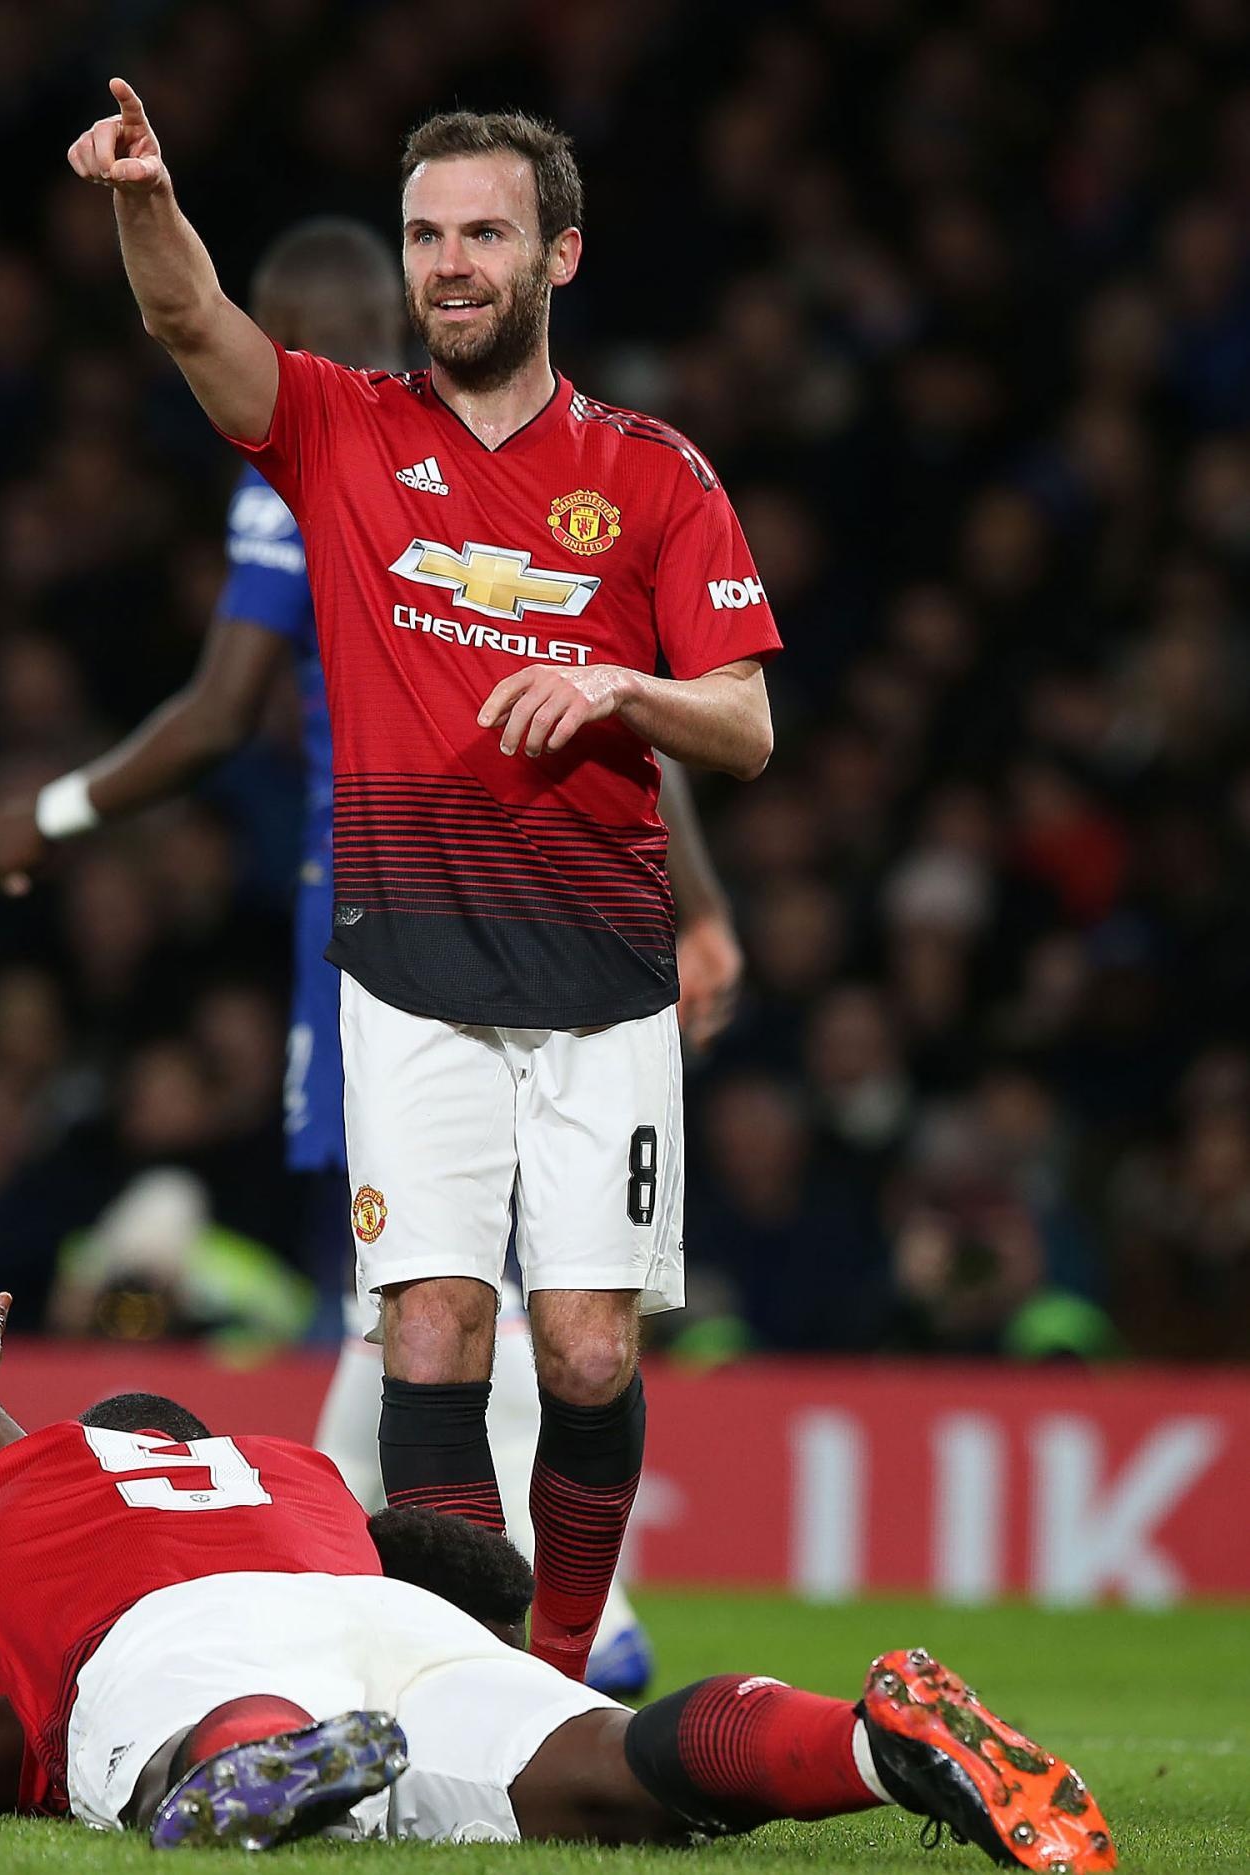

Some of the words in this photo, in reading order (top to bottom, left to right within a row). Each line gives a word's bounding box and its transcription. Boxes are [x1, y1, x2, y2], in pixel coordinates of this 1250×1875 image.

[395, 471, 449, 496] adidas
[556, 495, 615, 521] MANCHESTER
[562, 536, 603, 552] UNITED
[393, 604, 593, 666] CHEVROLET
[627, 1125, 657, 1226] 8
